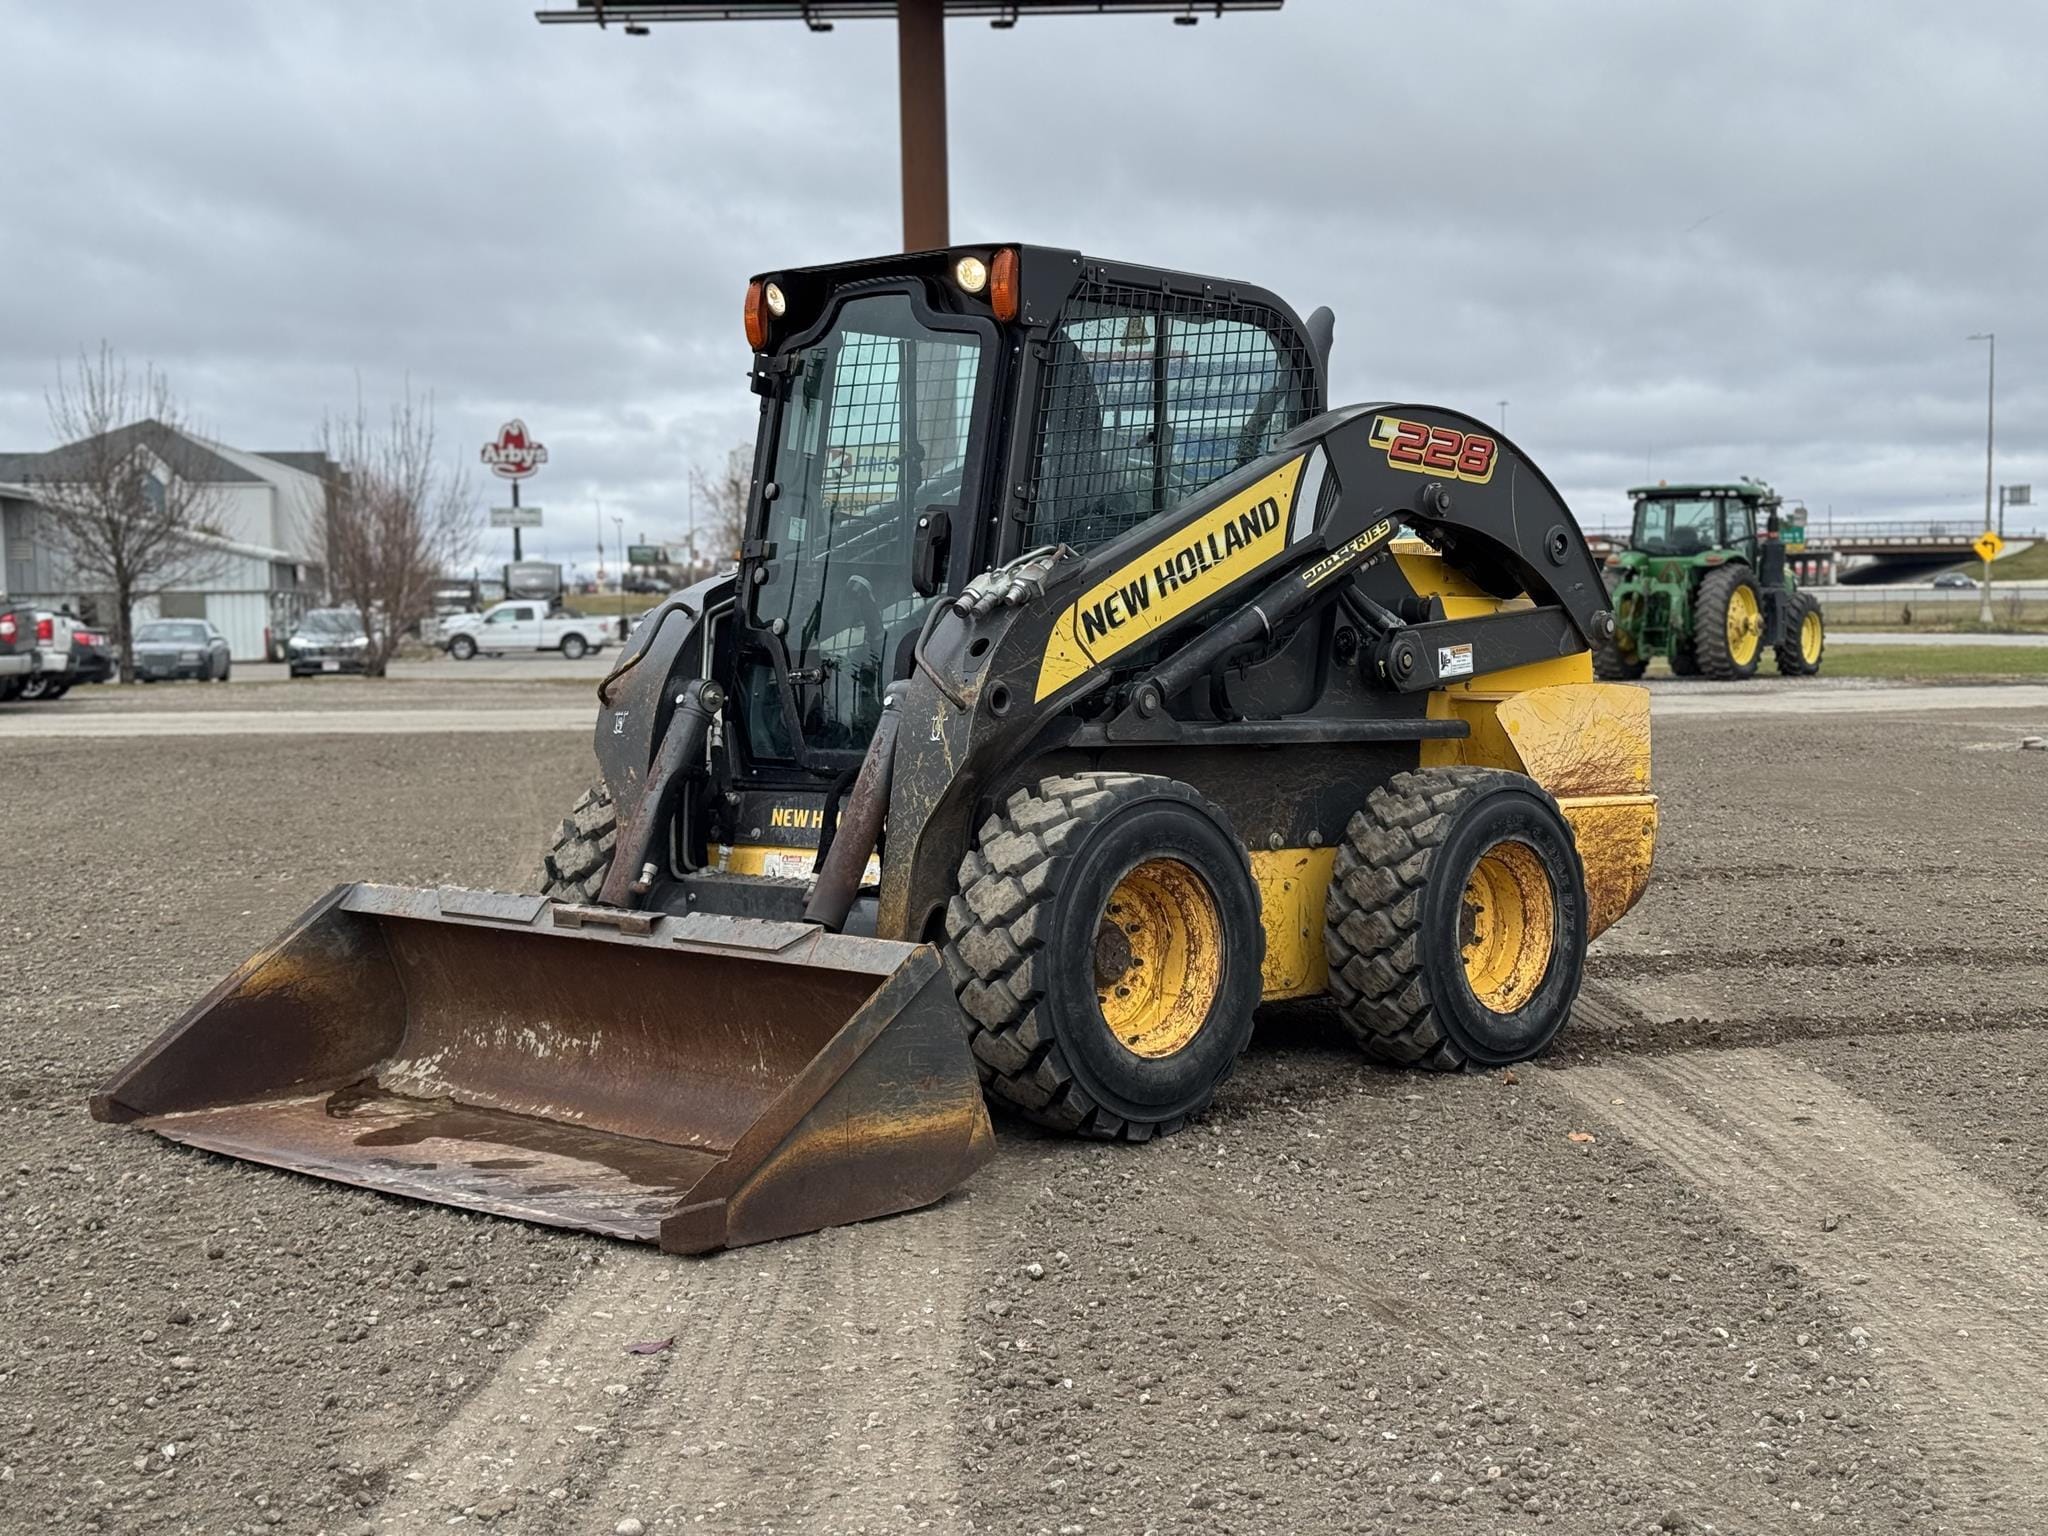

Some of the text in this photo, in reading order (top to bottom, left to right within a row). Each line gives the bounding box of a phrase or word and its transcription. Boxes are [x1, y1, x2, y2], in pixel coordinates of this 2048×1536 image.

[481, 442, 547, 468] Arby's
[1335, 519, 1391, 566] SERIES
[1081, 496, 1280, 645] NEW HOLLAND
[770, 808, 810, 828] NEW
